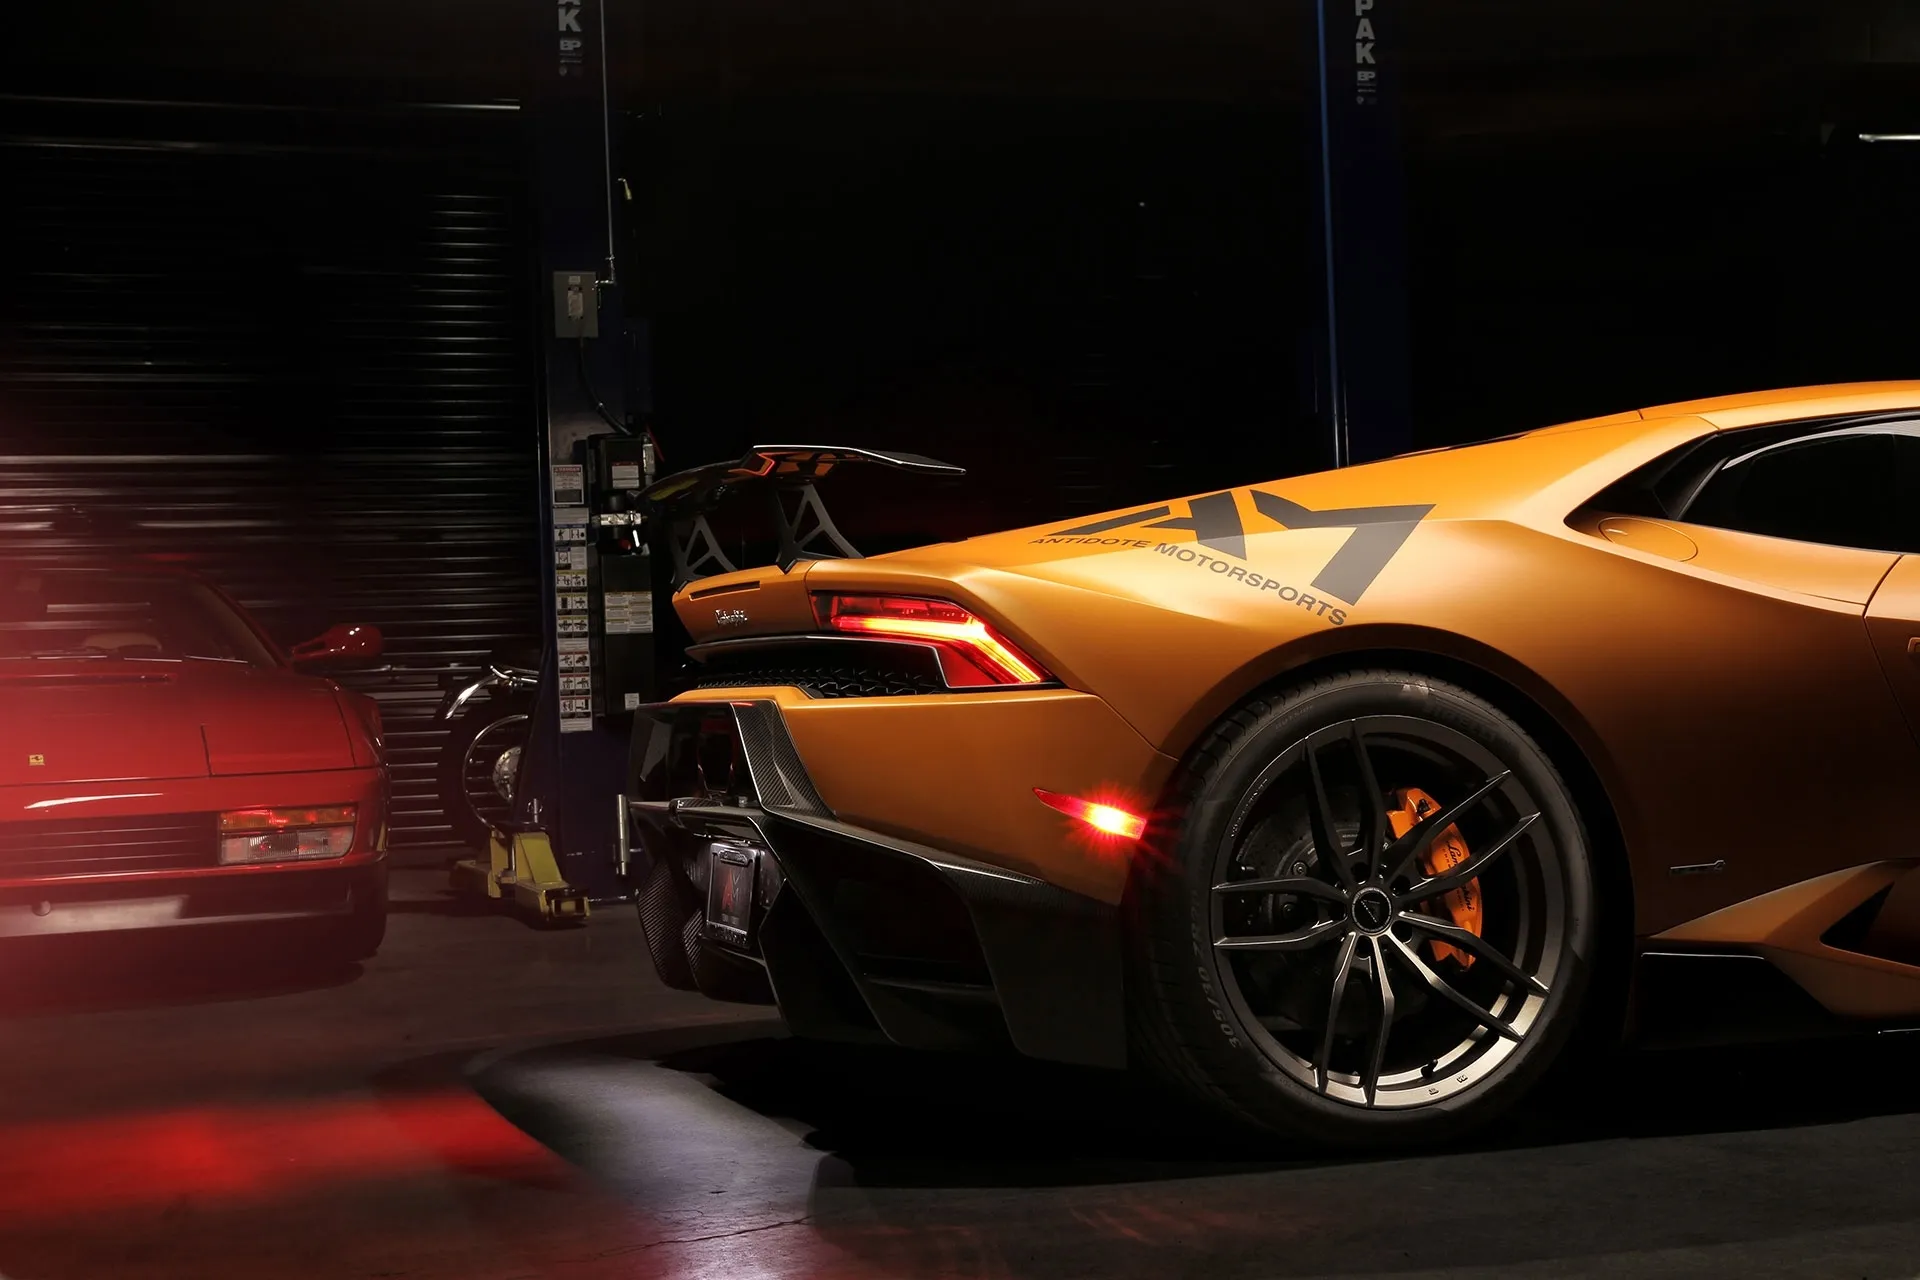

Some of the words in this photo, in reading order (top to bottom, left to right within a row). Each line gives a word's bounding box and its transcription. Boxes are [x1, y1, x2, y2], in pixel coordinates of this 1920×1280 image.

[557, 0, 582, 32] K
[1355, 0, 1376, 64] PAK
[1028, 537, 1151, 548] ANTIDOTE
[1153, 542, 1347, 626] MOTORSPORTS
[1197, 966, 1243, 1050] 305/30
